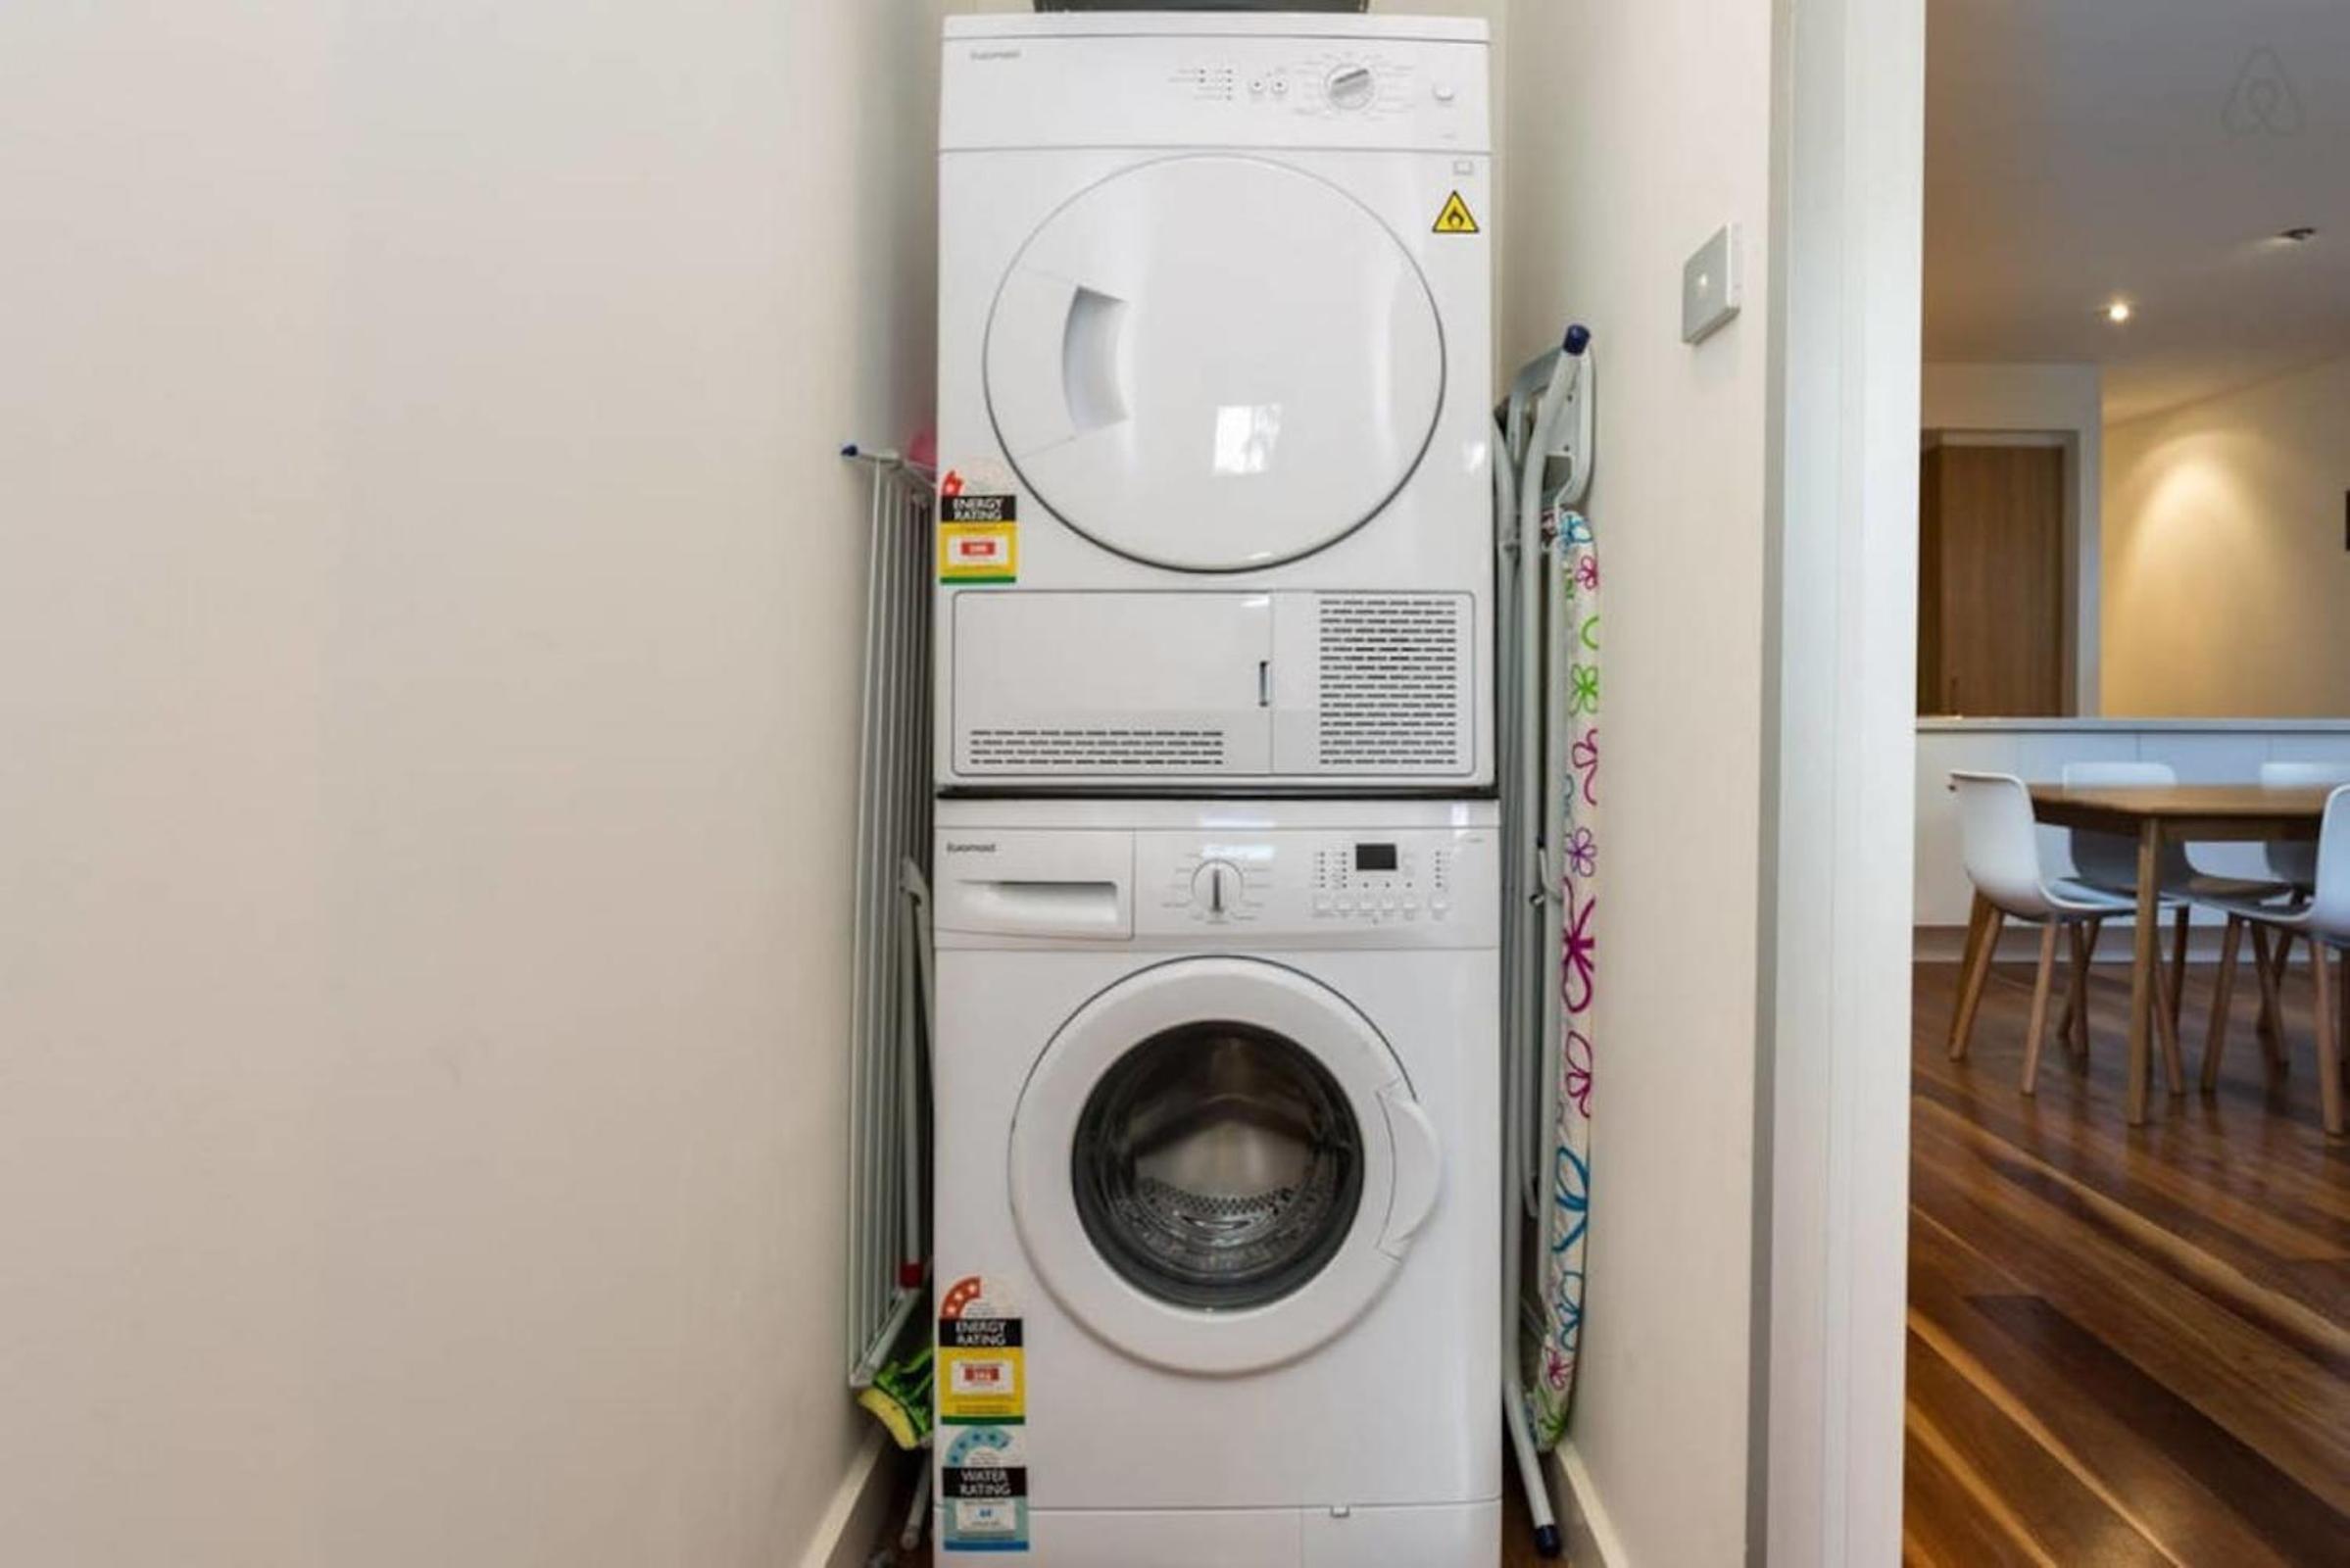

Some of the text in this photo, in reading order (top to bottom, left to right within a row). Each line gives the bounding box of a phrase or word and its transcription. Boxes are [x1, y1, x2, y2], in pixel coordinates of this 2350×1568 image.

[955, 511, 1003, 521] RATING
[955, 1320, 1006, 1333] ENERGY
[956, 1333, 1006, 1346] RATING
[960, 1469, 1008, 1482] WATER
[960, 1482, 1011, 1495] RATING
